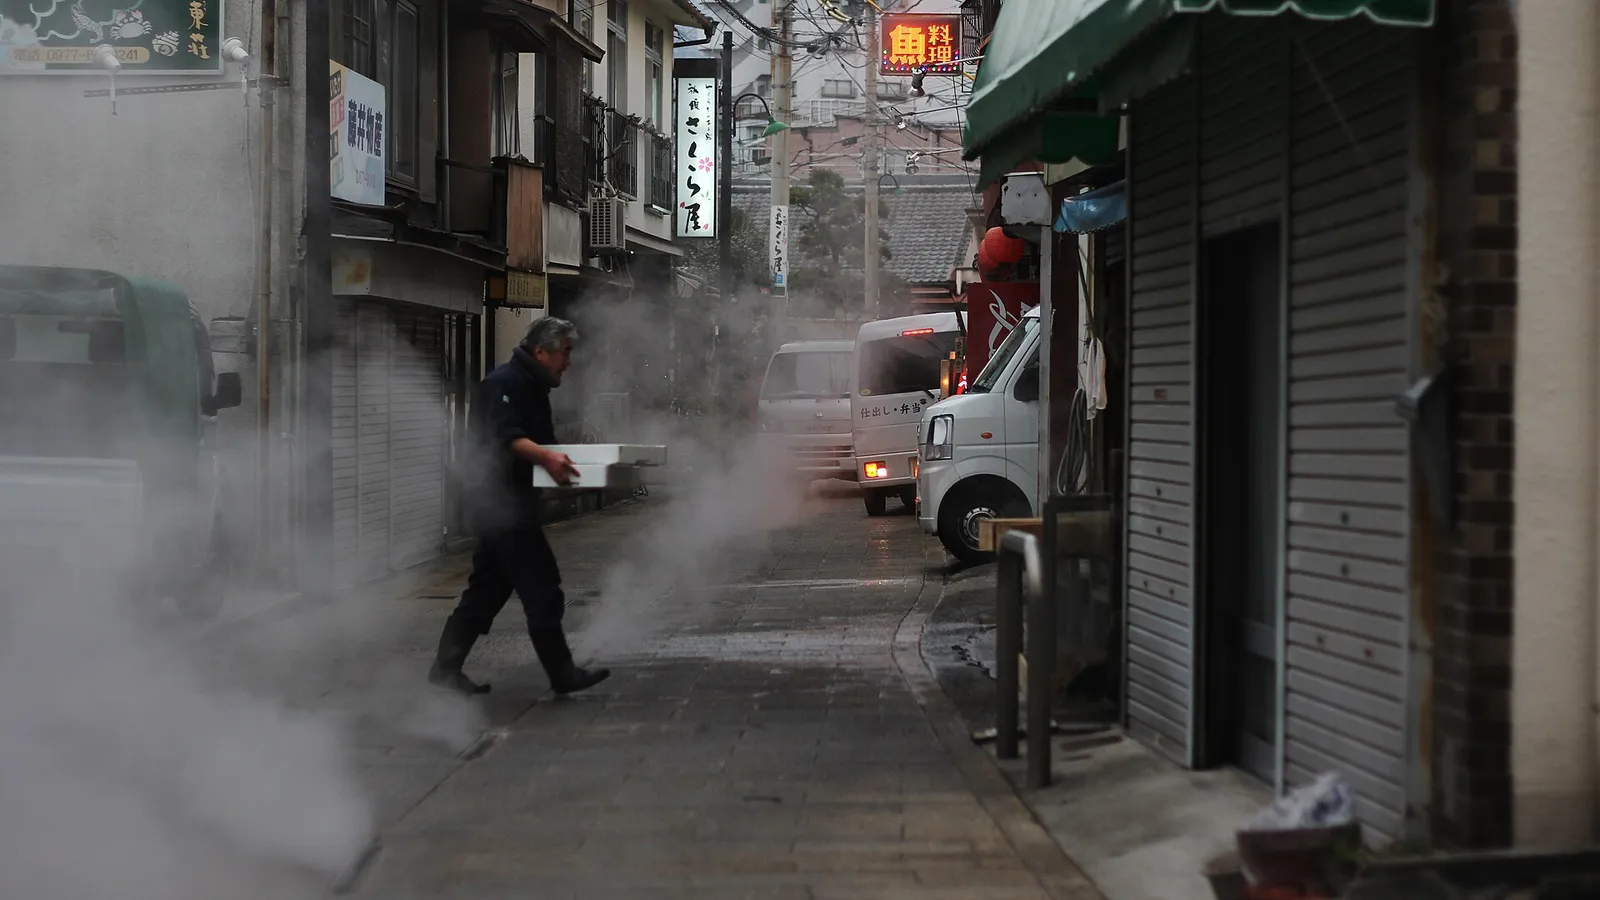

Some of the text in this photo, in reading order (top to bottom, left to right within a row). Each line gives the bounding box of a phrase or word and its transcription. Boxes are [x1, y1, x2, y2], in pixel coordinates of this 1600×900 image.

[47, 48, 138, 61] 0977-6241
[348, 99, 383, 157] 藤井物産
